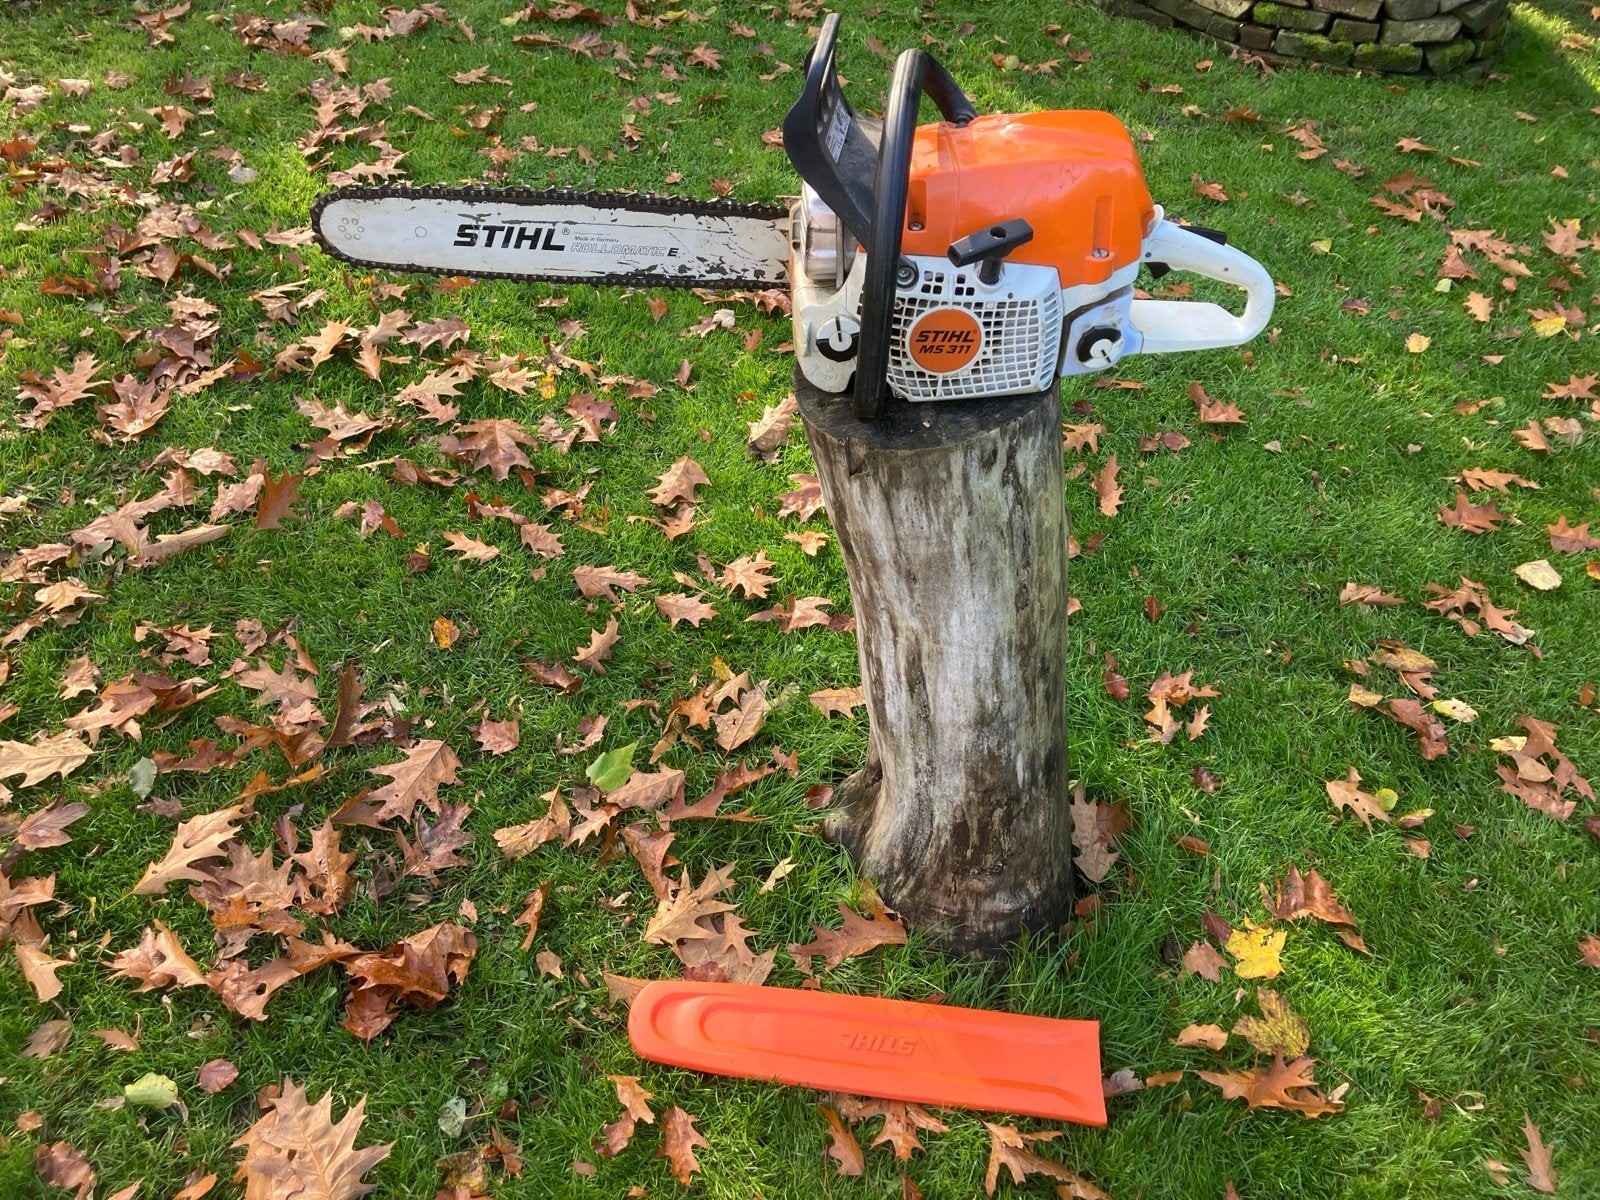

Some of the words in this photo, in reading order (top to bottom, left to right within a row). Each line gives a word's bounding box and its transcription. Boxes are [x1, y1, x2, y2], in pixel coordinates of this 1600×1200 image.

[453, 223, 565, 252] STIHL
[571, 242, 666, 257] ROLLOMATIC
[667, 247, 679, 257] E
[915, 330, 975, 343] STIHL
[919, 344, 945, 354] MS
[946, 344, 972, 354] 311
